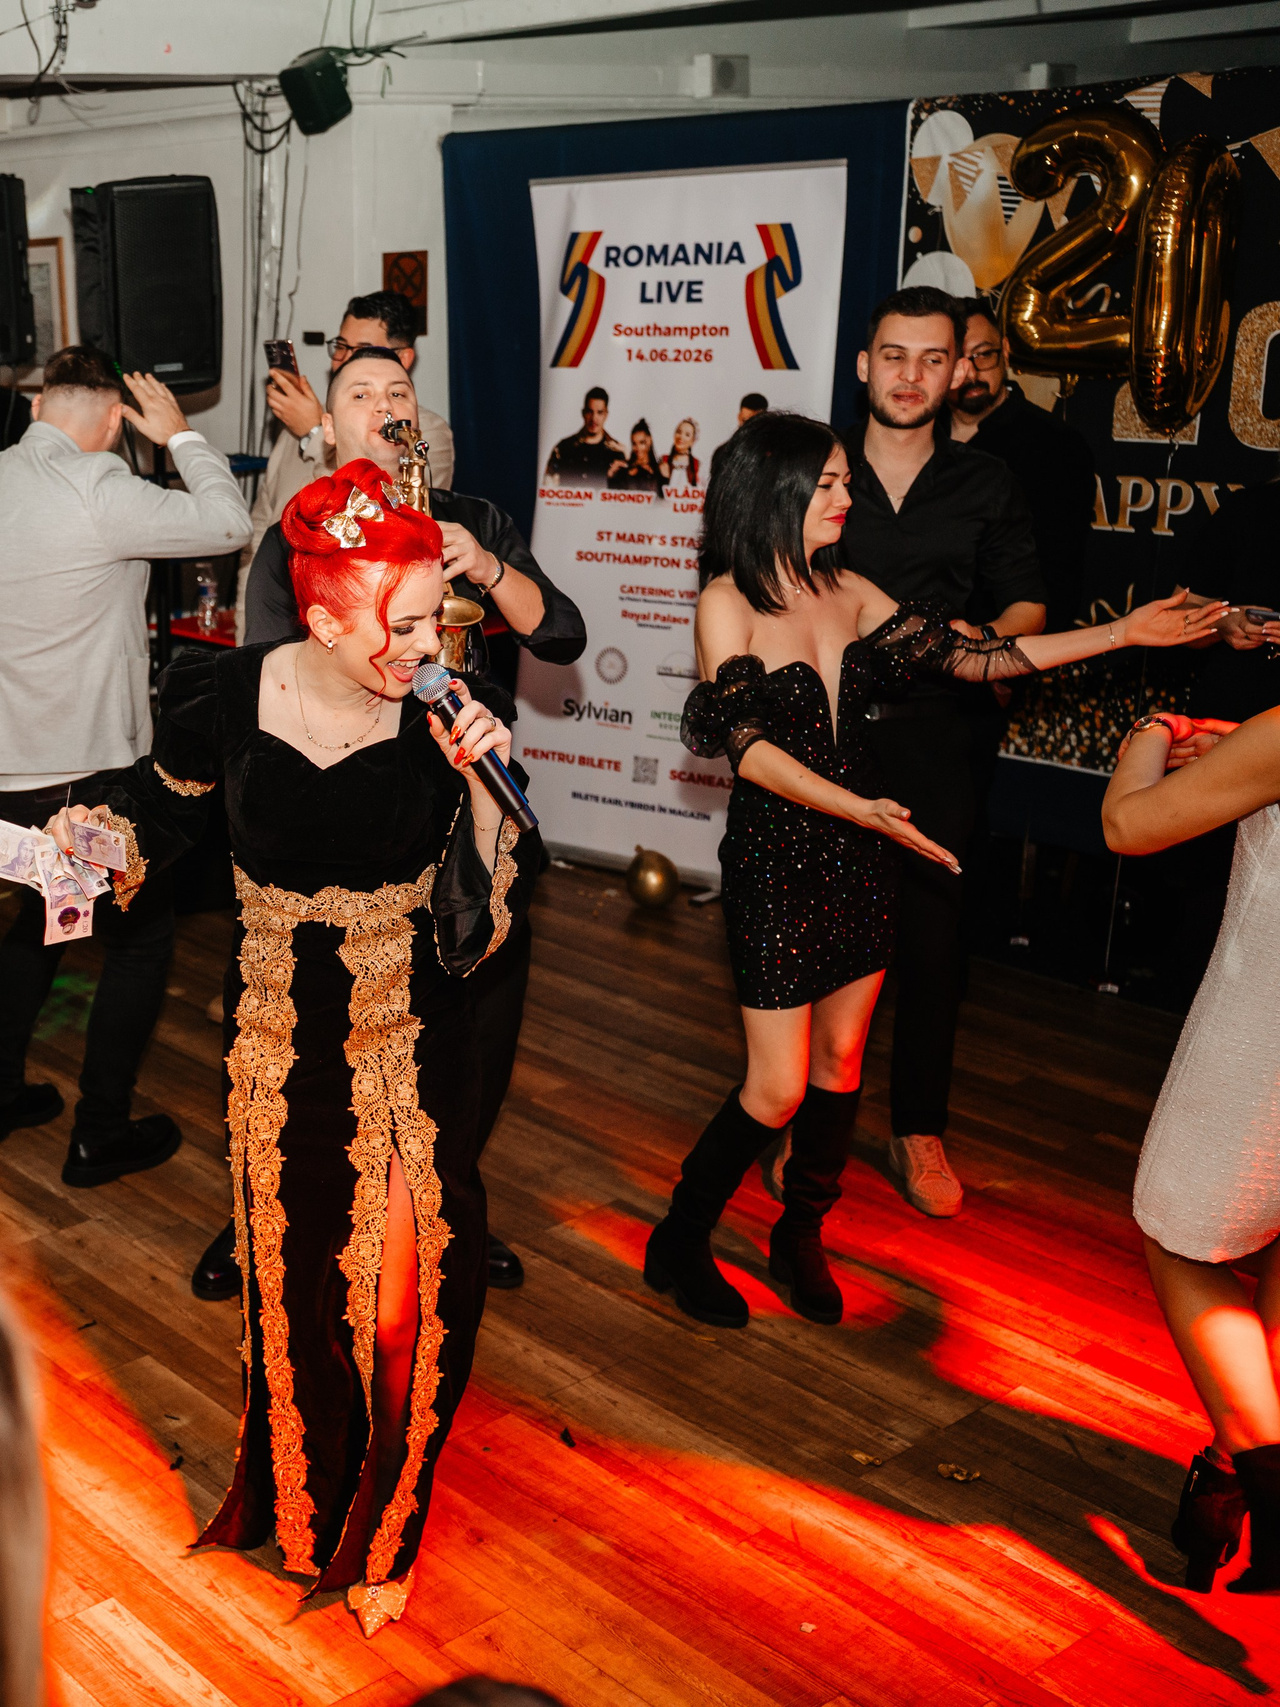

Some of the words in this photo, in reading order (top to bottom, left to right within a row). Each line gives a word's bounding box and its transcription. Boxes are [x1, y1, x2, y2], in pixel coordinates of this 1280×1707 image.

[604, 241, 746, 268] ROMANIA
[640, 280, 704, 304] LIVE
[613, 323, 730, 340] Southampton
[626, 348, 714, 363] 14.06.2026
[538, 488, 593, 500] BOGDAN
[600, 492, 654, 504] SHONDY
[595, 530, 613, 543] ST
[615, 532, 667, 547] MARY'S
[670, 535, 703, 549] STA
[575, 550, 680, 569] SOUTHAMPTON
[619, 584, 675, 599] CATERING
[621, 609, 651, 623] Royal
[653, 612, 690, 626] Palace
[563, 698, 633, 725] Sylvian
[522, 747, 576, 765] PENTRU
[578, 755, 623, 773] BILETE
[571, 791, 600, 804] BILETE
[669, 808, 712, 822] MAGAZIN
